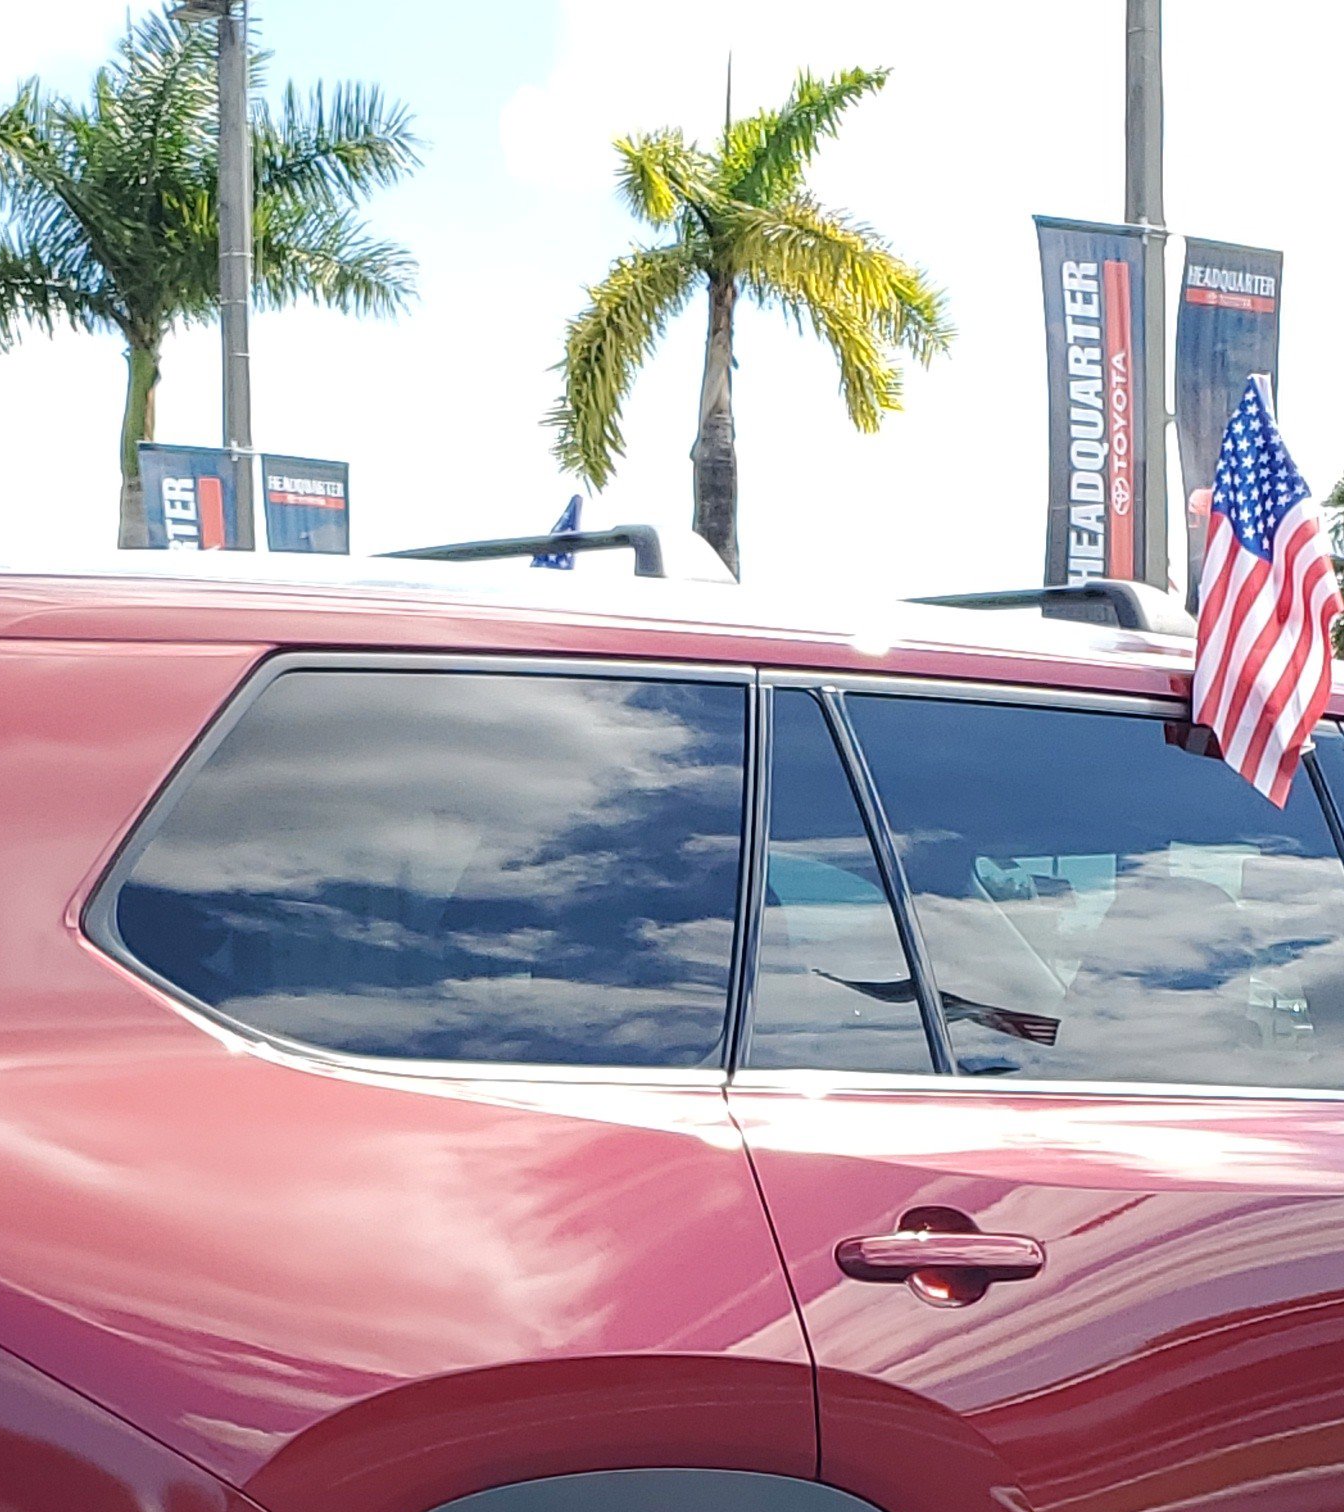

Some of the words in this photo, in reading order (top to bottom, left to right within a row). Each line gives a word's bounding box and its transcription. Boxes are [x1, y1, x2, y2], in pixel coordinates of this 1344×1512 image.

[1187, 264, 1275, 297] HEADQUARTER
[1062, 259, 1109, 588] HEADQUARTER
[1111, 352, 1128, 474] TOYOTA
